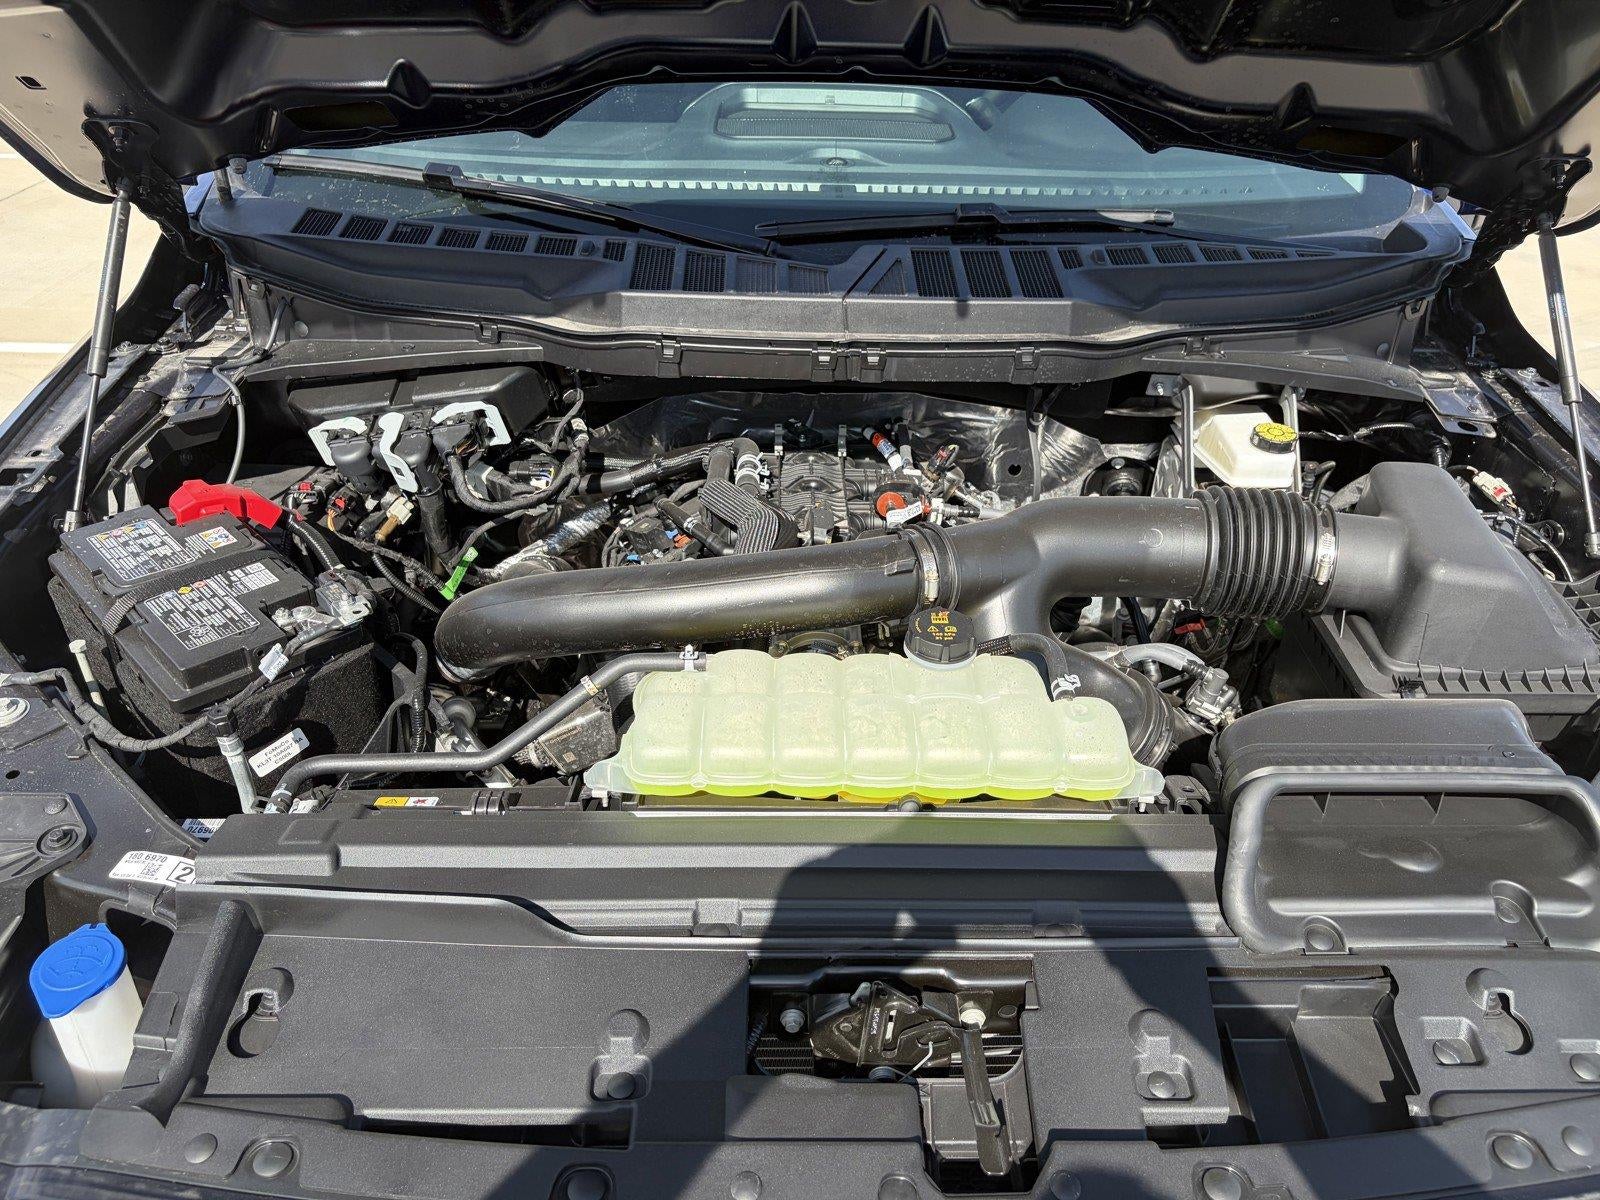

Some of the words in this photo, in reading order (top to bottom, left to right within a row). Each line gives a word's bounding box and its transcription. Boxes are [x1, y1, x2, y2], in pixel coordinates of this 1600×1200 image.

[187, 826, 219, 834] 06970
[144, 853, 168, 863] 6970
[175, 866, 194, 882] 2
